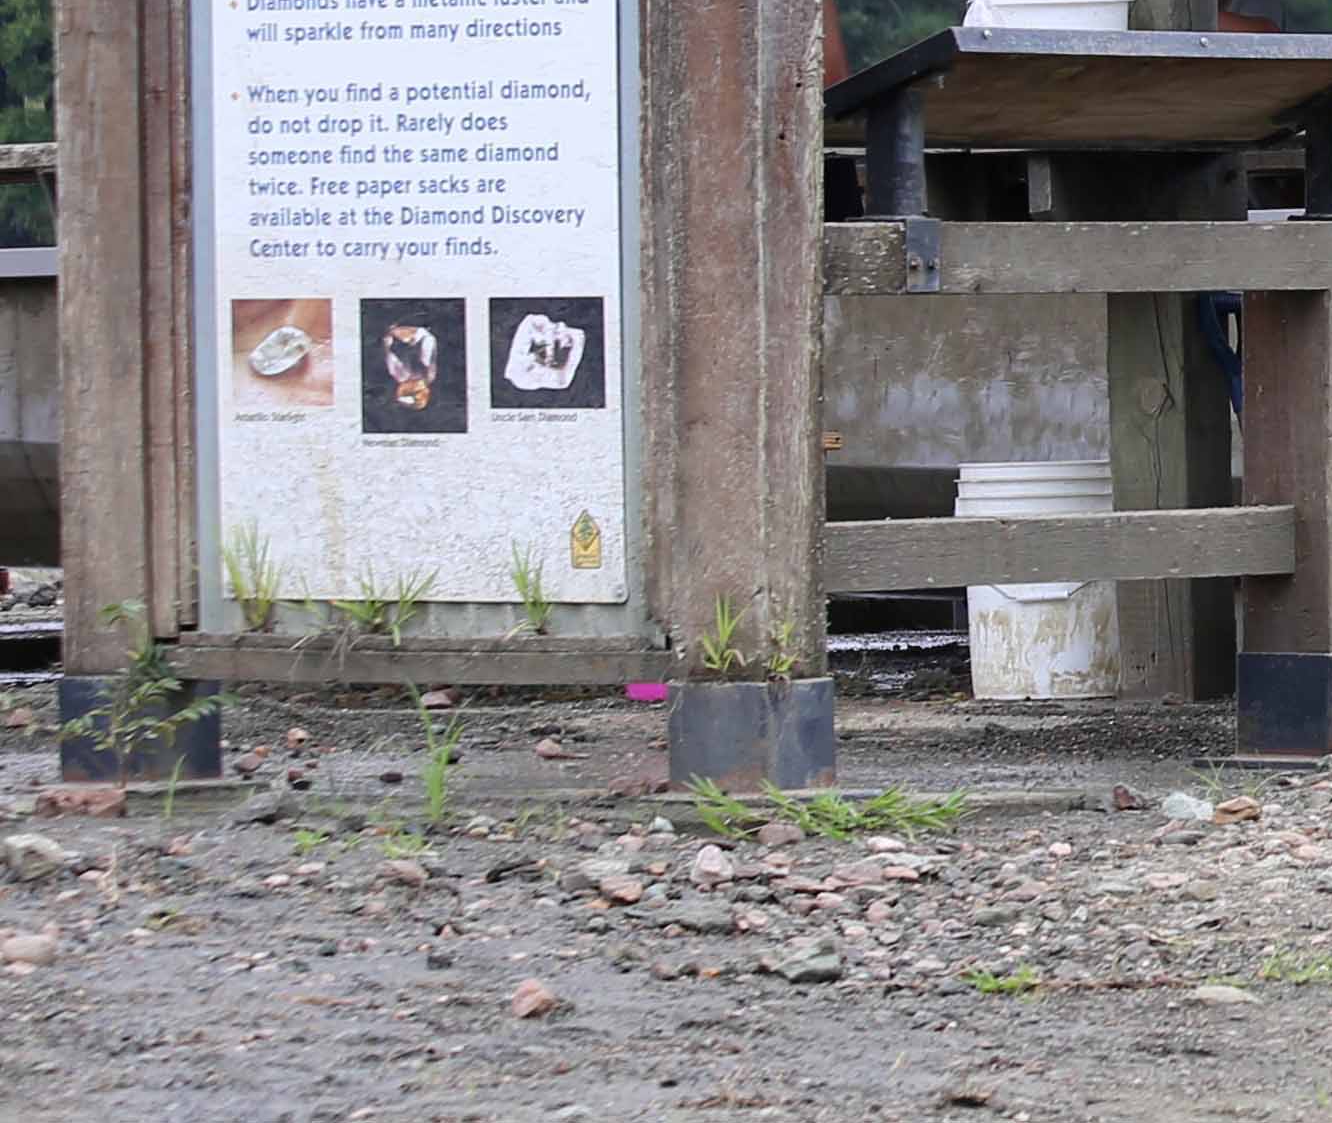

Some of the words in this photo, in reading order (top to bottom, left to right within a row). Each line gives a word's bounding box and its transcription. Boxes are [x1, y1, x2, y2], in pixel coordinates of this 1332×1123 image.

[246, 23, 277, 42] will
[284, 22, 354, 45] sparkle
[360, 20, 403, 40] from
[410, 24, 459, 42] many
[466, 18, 562, 38] directions
[247, 85, 299, 103] When
[304, 88, 339, 107] you
[346, 83, 382, 102] find
[389, 87, 399, 101] a
[406, 80, 493, 105] potential
[500, 79, 590, 102] diamond,
[248, 116, 273, 134] do
[280, 116, 311, 134] not
[318, 114, 363, 137] drop
[370, 114, 389, 132] it.
[397, 113, 455, 136] Rarely
[460, 112, 508, 131] does
[248, 150, 333, 166] someone
[339, 145, 376, 164] find
[383, 144, 414, 163] the
[420, 148, 468, 163] same
[475, 142, 558, 162] diamond
[248, 177, 303, 196] twice.
[310, 177, 350, 196] Free
[356, 180, 412, 199] paper
[418, 174, 470, 194] sacks
[477, 178, 506, 193] are
[249, 207, 332, 227] available
[338, 208, 357, 226] at
[364, 207, 394, 226] the
[400, 205, 484, 225] Diamond
[492, 205, 585, 228] Discovery
[249, 239, 310, 258] Center
[315, 239, 336, 257] to
[343, 242, 390, 260] carry
[393, 242, 439, 263] your
[445, 236, 498, 255] finds.
